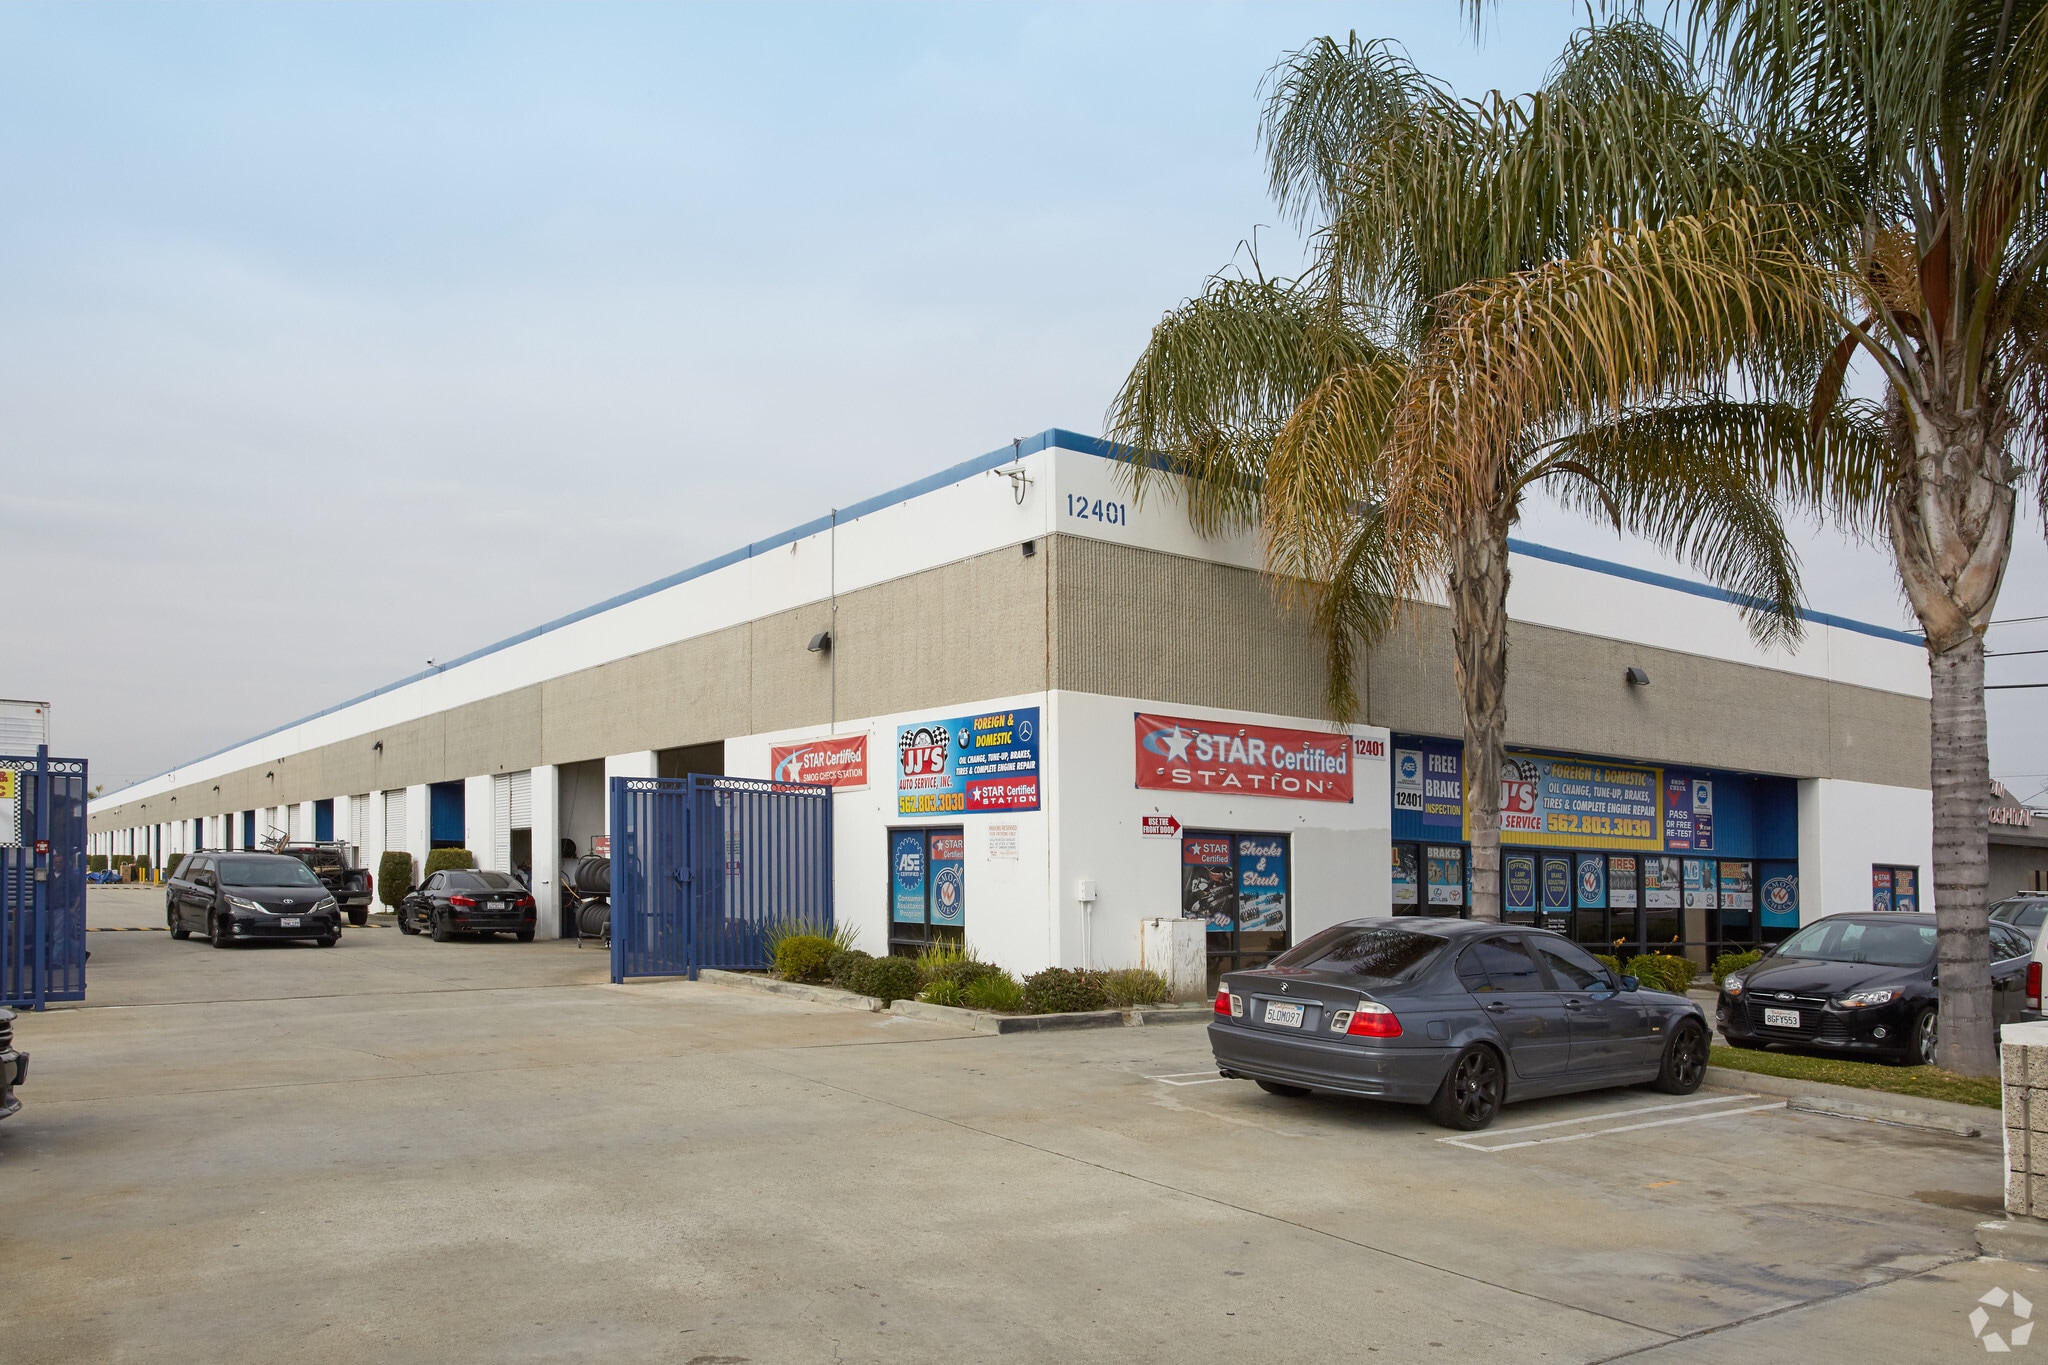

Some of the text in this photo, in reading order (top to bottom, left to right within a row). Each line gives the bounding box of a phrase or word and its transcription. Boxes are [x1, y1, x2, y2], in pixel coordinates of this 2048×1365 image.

[1068, 493, 1126, 526] 12401
[973, 714, 1014, 730] FOREIGN &
[976, 732, 1012, 747] DOMESTIC
[1196, 733, 1346, 774] STAR Certified
[1355, 740, 1384, 757] 12401
[804, 747, 861, 768] STAR Certified
[904, 747, 944, 774] JJ'S
[968, 755, 987, 764] CHANGE,
[1010, 750, 1031, 760] BRAKES,
[1428, 754, 1456, 773] FREE!
[803, 768, 862, 782] SMOG CHECK STATION
[956, 767, 968, 775] TIRES
[974, 764, 996, 774] COMPLETE
[998, 762, 1015, 771] ENGINE
[1017, 761, 1035, 770] REPAIR
[1551, 764, 1646, 786] FOREIGN & DOMESTIC
[899, 776, 952, 790] AUTO SERVICE, INC.
[1172, 769, 1323, 793] STATION
[982, 784, 1035, 797] STAR Certified
[1425, 779, 1460, 799] BRAKE
[1548, 783, 1650, 803] OIL CHANGE, TUNE-UP, BRAKES,
[899, 793, 964, 813] 562.803.3030
[983, 796, 1036, 804] STATION
[1396, 792, 1422, 807] 12401
[1501, 782, 1533, 811] J'S
[1425, 803, 1460, 815] INSPECTION
[1544, 798, 1655, 817] TIRES & COMPLETE ENGINE REPAIR
[1669, 810, 1688, 819] PASS
[1160, 818, 1168, 826] THE
[1506, 815, 1541, 829] SERVICE
[1988, 806, 2033, 827] OSPITAL
[1160, 826, 1174, 834] DOOR
[1548, 813, 1650, 837] 562.803.3030
[1667, 829, 1692, 837] RE-TEST
[945, 840, 963, 848] STAR
[1203, 844, 1228, 853] STAR
[1240, 841, 1282, 857] Shocks
[1201, 854, 1228, 862] Certified
[1427, 847, 1461, 858] BRAKES
[899, 854, 920, 871] ASE
[1256, 858, 1266, 871] &
[1609, 858, 1635, 871] TIRES
[938, 873, 958, 887] SMOG
[1242, 871, 1279, 886] Struts
[1645, 877, 1660, 888] OIL
[1767, 881, 1790, 891] SMOG
[938, 899, 959, 914] CHECK
[1767, 898, 1793, 910] CHECK
[1767, 1015, 1797, 1025] 8GFY553
